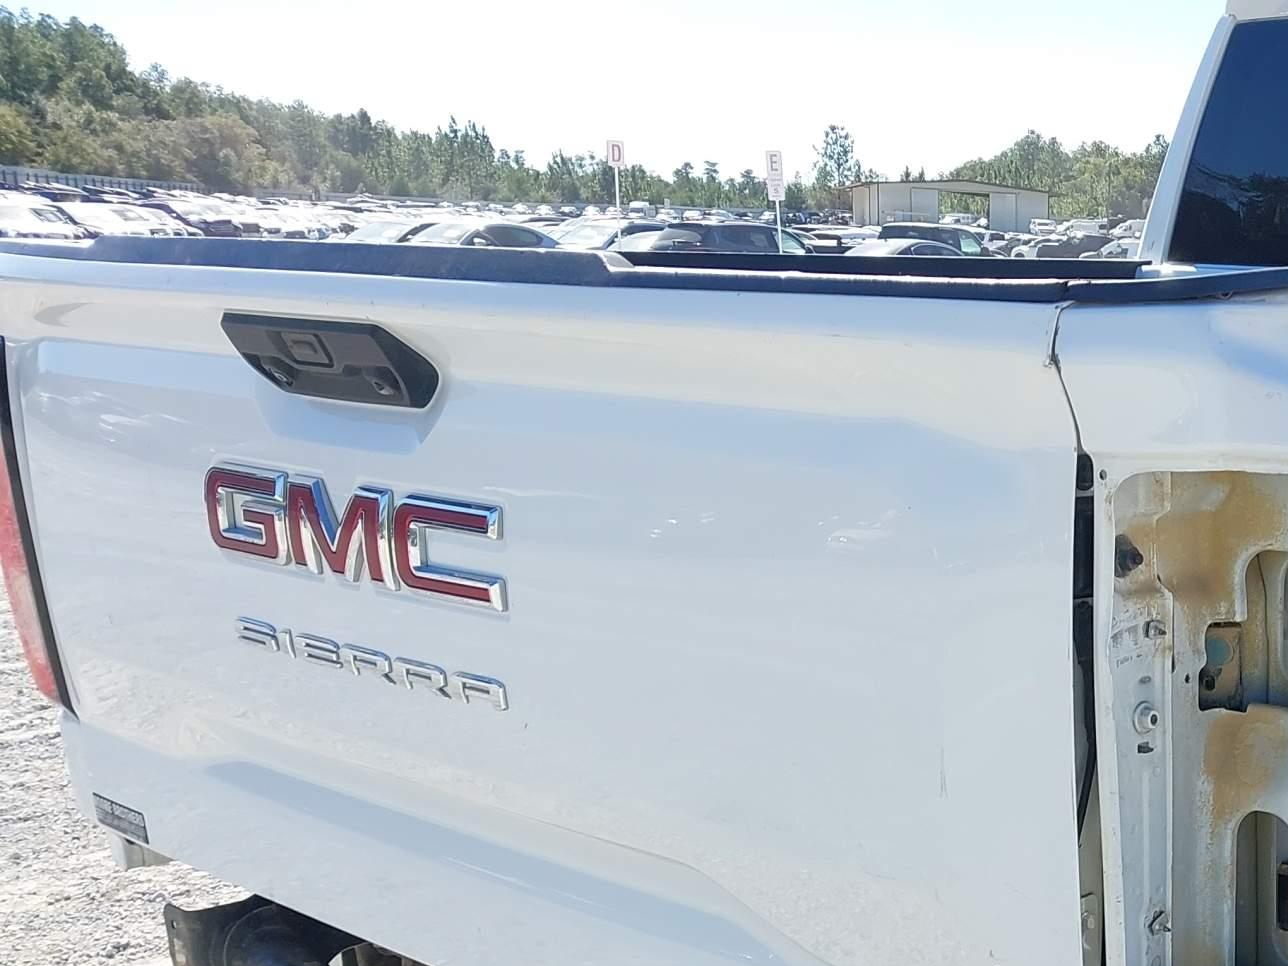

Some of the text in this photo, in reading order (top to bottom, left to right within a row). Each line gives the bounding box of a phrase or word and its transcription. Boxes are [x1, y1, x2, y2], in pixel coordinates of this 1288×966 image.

[611, 143, 622, 162] D
[769, 153, 779, 172] E
[204, 463, 509, 613] GMC
[236, 615, 509, 712] SIERRA
